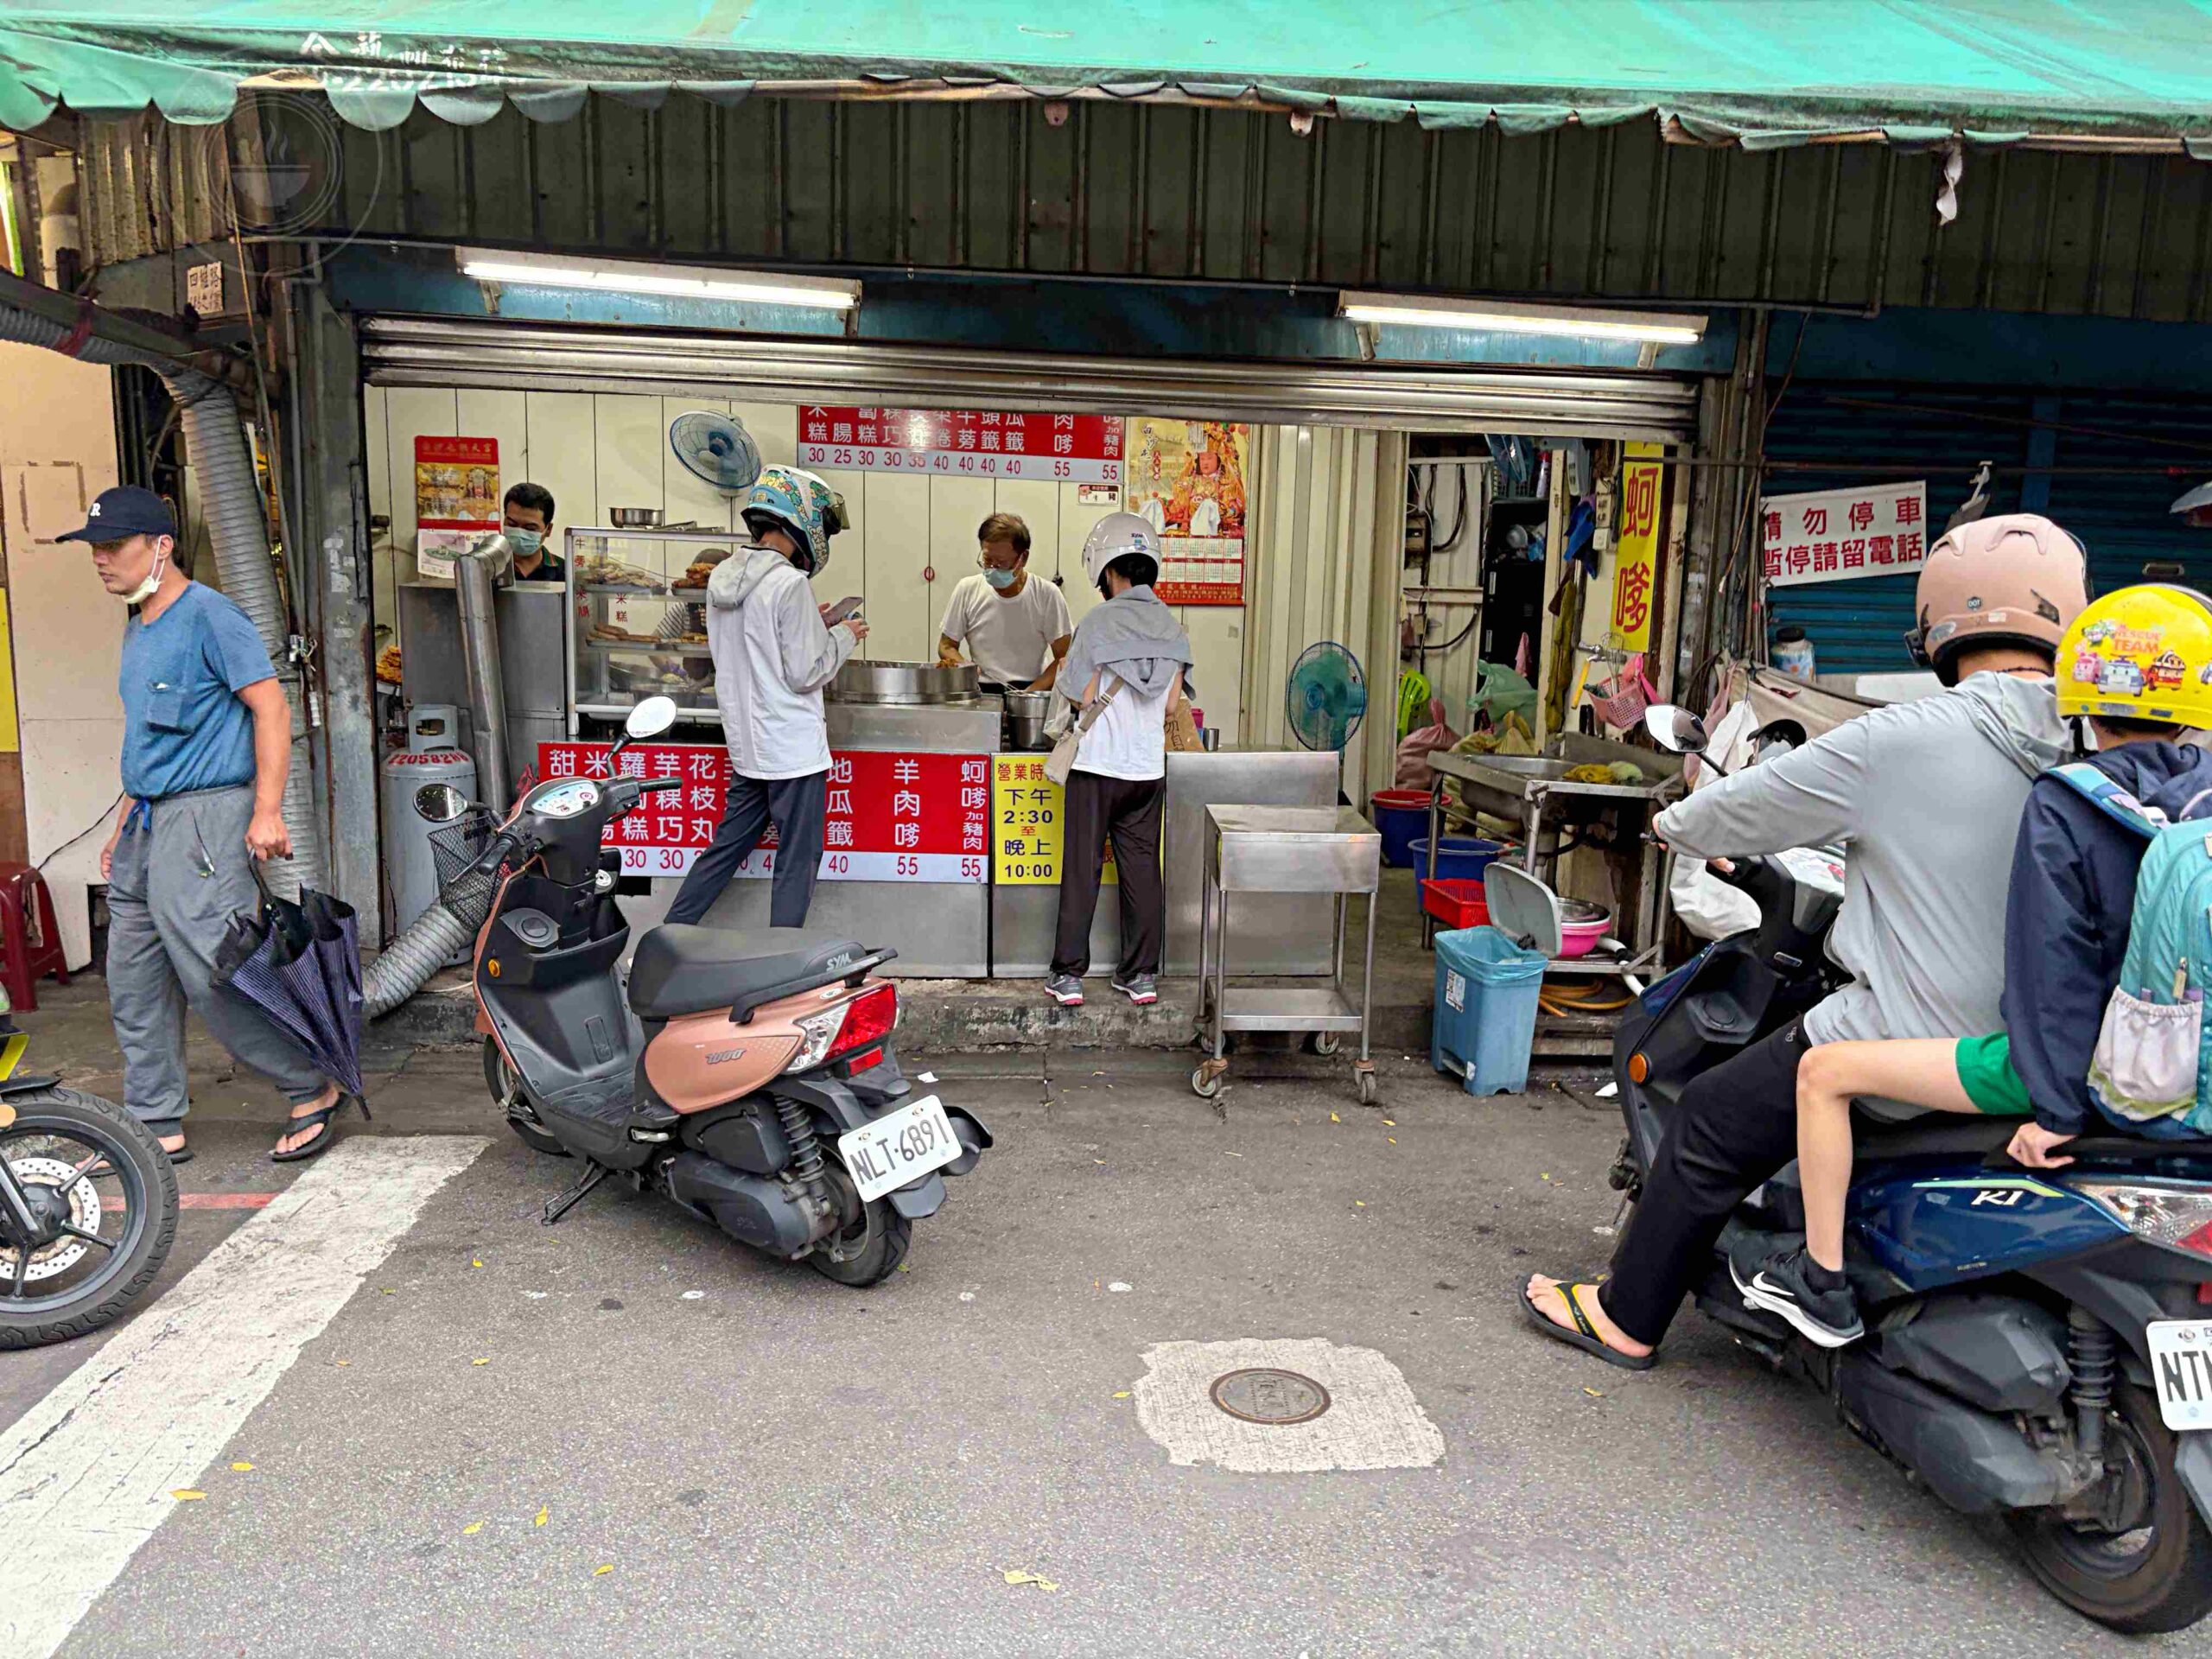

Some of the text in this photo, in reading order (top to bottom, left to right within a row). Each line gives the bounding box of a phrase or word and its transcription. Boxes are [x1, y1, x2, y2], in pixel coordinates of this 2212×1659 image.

[808, 447, 825, 462] 30
[834, 448, 852, 464] 25
[858, 450, 874, 466] 30
[883, 451, 902, 467] 30
[933, 455, 949, 470] 40
[958, 456, 974, 471] 40
[981, 458, 996, 473] 40
[1006, 460, 1021, 474] 40
[1054, 461, 1071, 476] 55
[1102, 464, 1118, 480] 55
[90, 502, 101, 517] R
[1764, 496, 1921, 542] 請勿停車
[1615, 467, 1659, 632] 蚵嗲
[1764, 532, 1923, 578] 暫停請留電話
[2113, 639, 2159, 653] TEAM
[998, 763, 1051, 782] 營業時
[620, 751, 650, 841] 蘿糕
[654, 752, 683, 842] 芋粿巧
[690, 753, 718, 842] 花枝丸
[826, 757, 853, 847] 地瓜籤
[893, 759, 920, 848] 羊肉嗲
[961, 760, 987, 850] 蚵嗲加豬肉
[1004, 788, 1052, 806] 下午
[1004, 810, 1052, 823] 2:30
[1021, 825, 1036, 836] 至
[1004, 838, 1052, 856] 晚上
[625, 849, 646, 868] 30
[660, 849, 684, 869] 30
[829, 855, 849, 874] 40
[897, 856, 918, 875] 55
[961, 858, 981, 877] 55
[1005, 864, 1052, 878] 10:00
[827, 952, 851, 971] SYM
